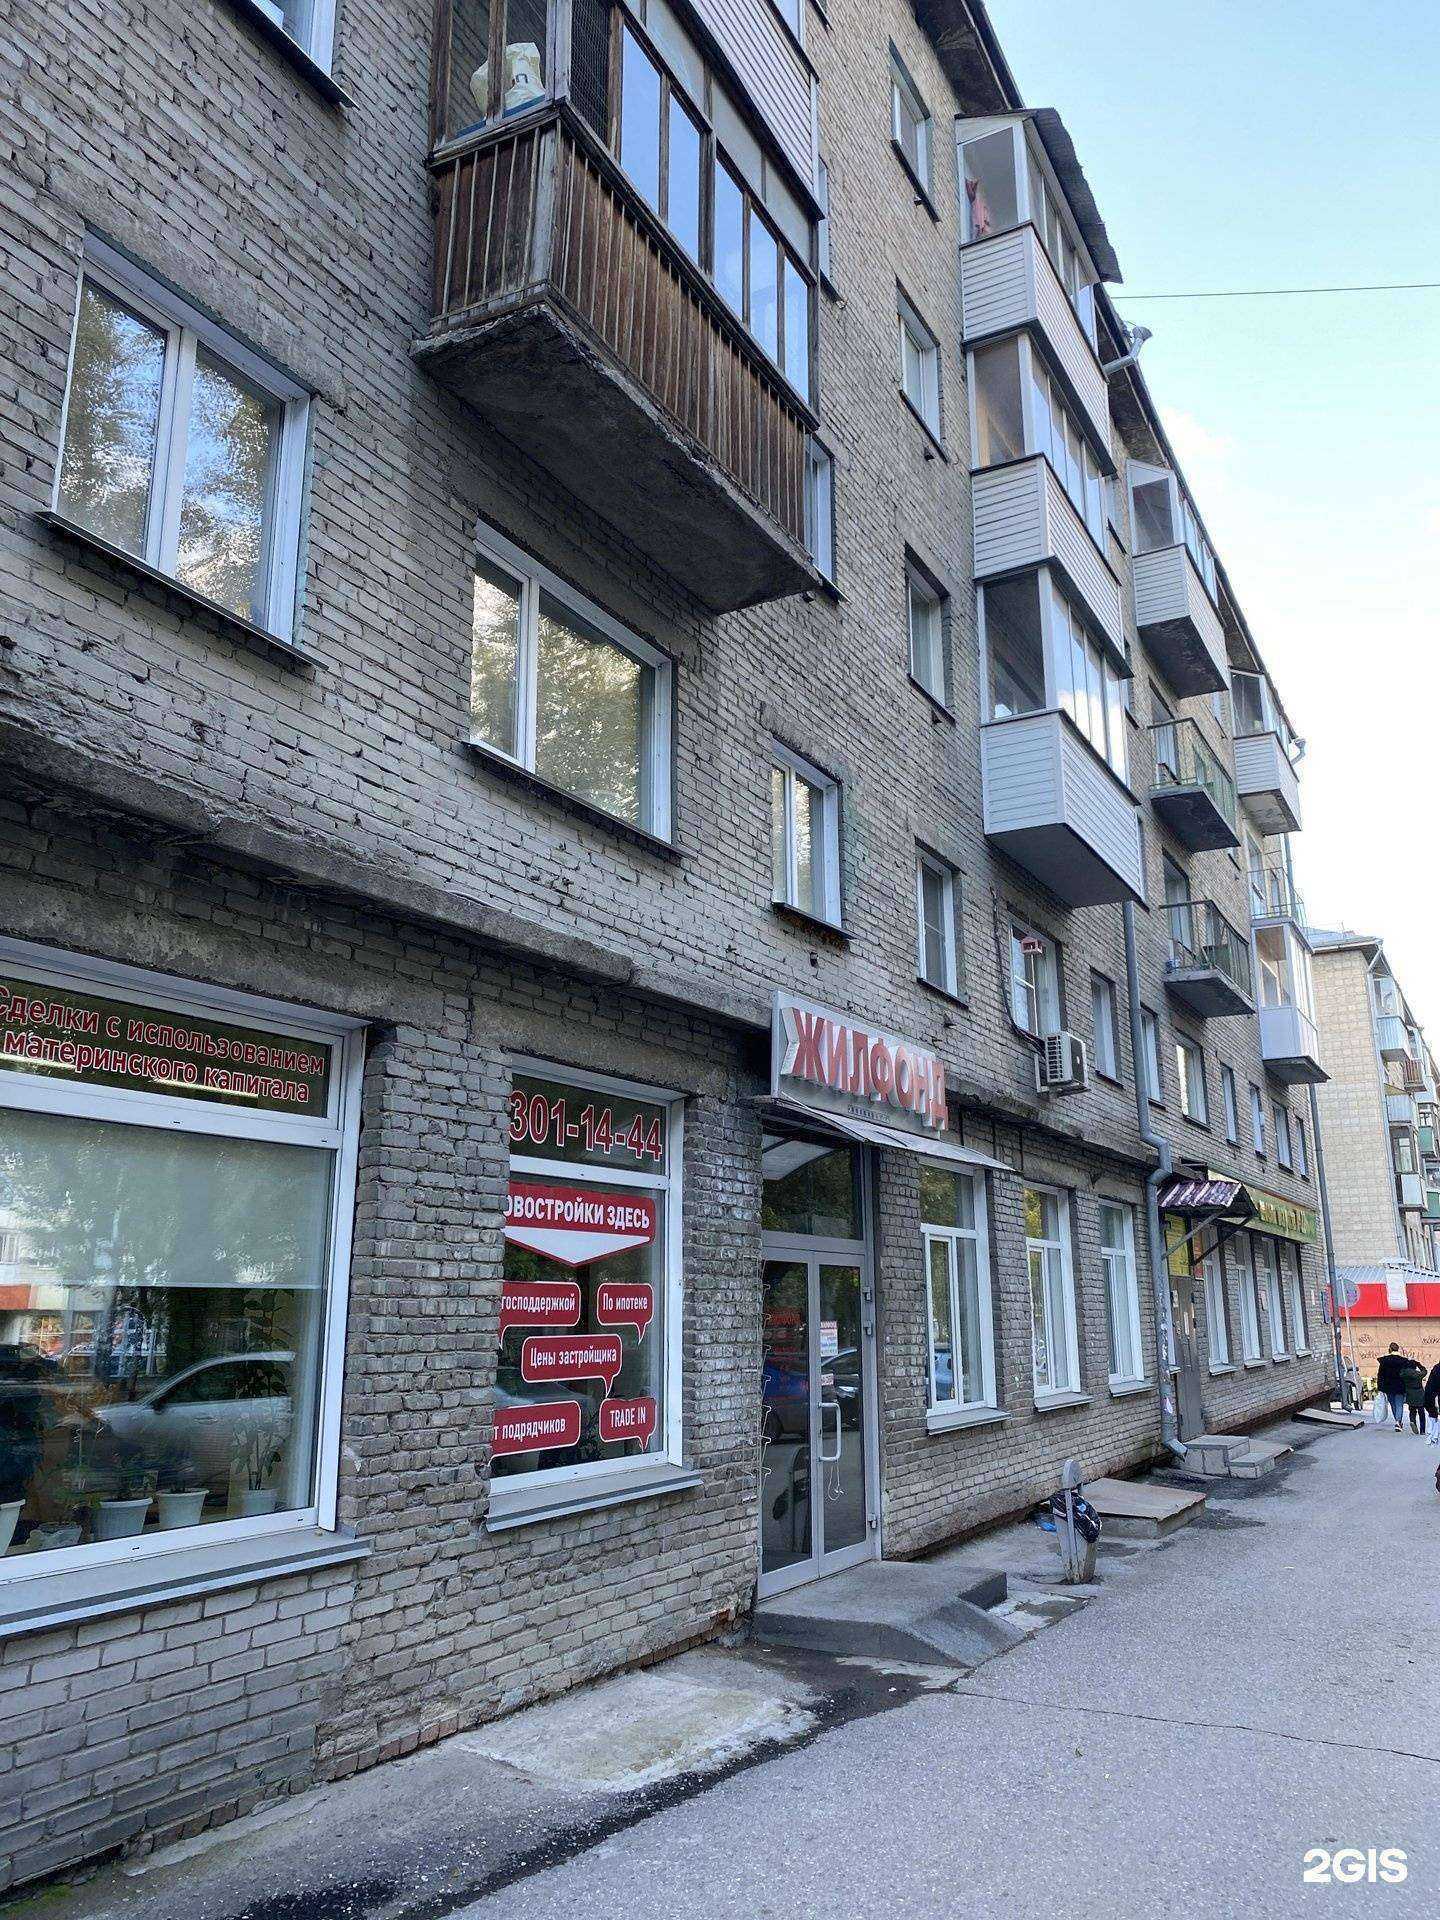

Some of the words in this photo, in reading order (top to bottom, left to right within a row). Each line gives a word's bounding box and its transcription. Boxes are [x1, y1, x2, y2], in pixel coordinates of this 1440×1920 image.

[106, 1015, 121, 1037] с
[127, 1018, 325, 1076] использованием
[3, 1030, 198, 1084] материнского
[204, 1066, 310, 1103] капитала
[781, 1007, 949, 1131] ЖИЛФОНД
[509, 1090, 663, 1162] 301-14-44
[607, 1205, 650, 1230] ЗДЕСЬ
[501, 1293, 575, 1316] господдержкой
[603, 1293, 614, 1311] По
[616, 1295, 648, 1311] ипотеке
[530, 1348, 556, 1369] Цены
[559, 1345, 617, 1369] застройщика
[610, 1408, 636, 1428] TRADE
[638, 1406, 646, 1425] IN
[502, 1418, 566, 1443] подрядчиков
